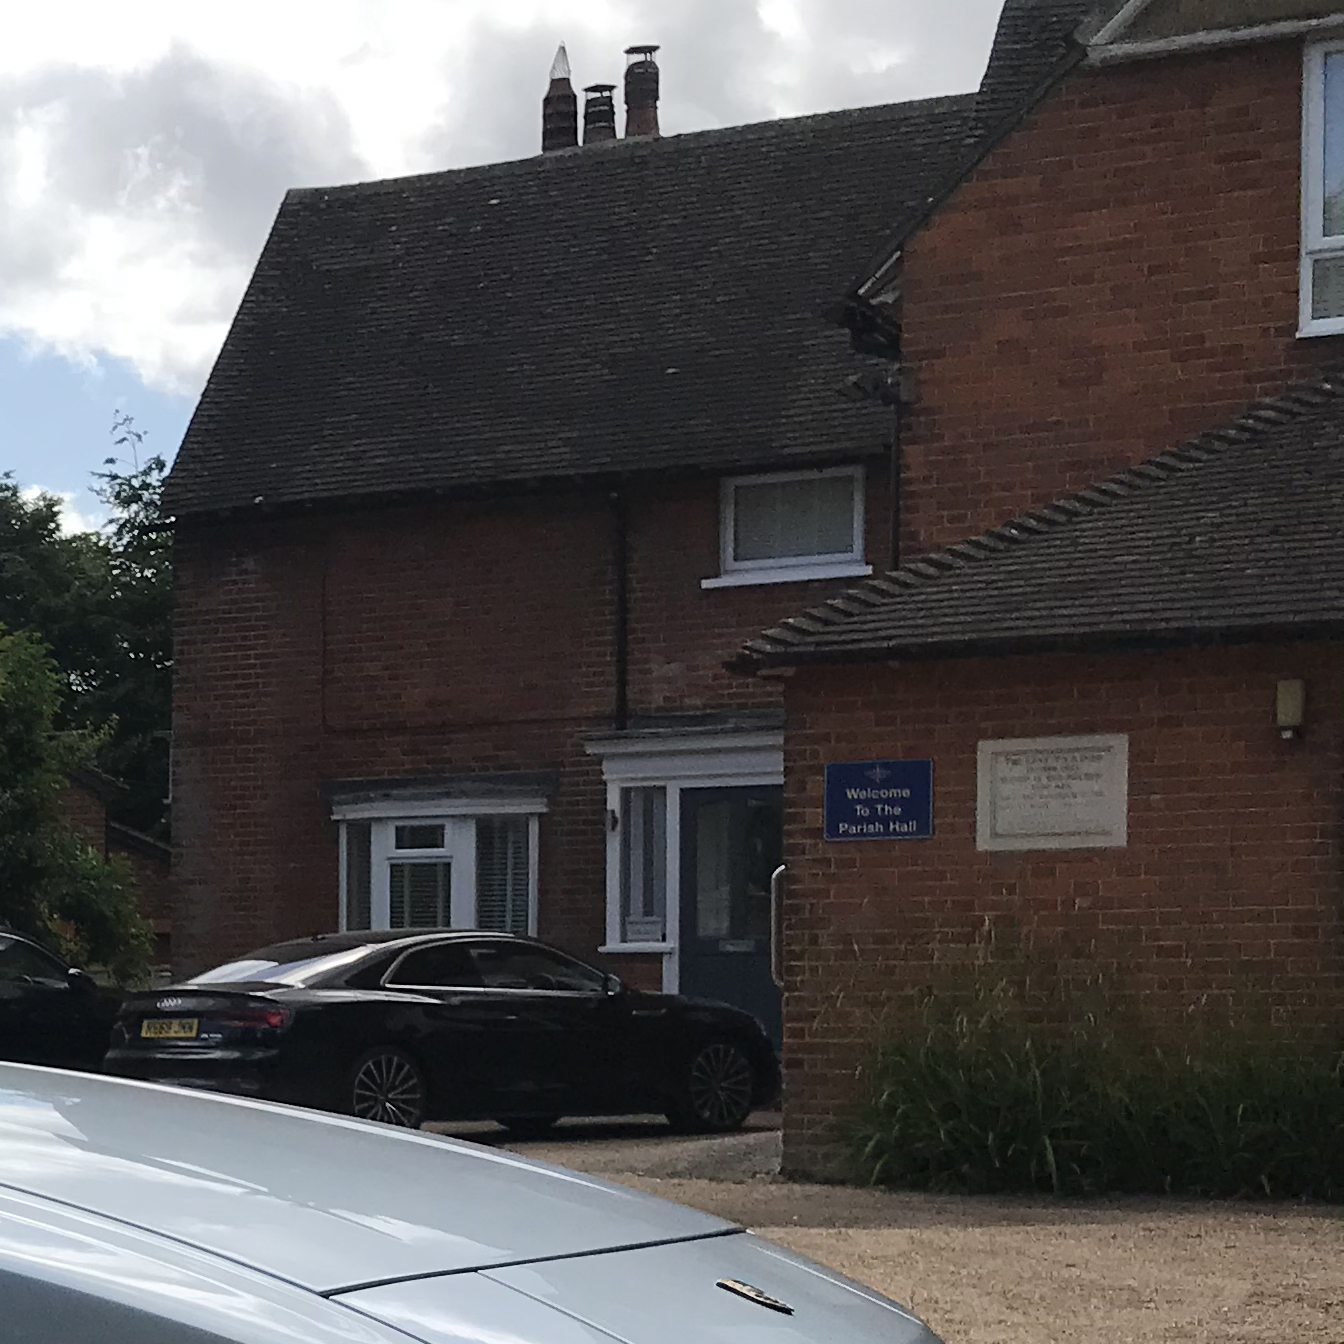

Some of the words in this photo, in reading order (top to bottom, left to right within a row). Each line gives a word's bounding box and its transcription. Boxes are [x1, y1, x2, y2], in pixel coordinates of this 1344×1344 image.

[846, 787, 911, 800] Welcome
[855, 804, 870, 817] To
[874, 803, 902, 816] The
[839, 821, 884, 835] Parish
[889, 819, 917, 833] Hall
